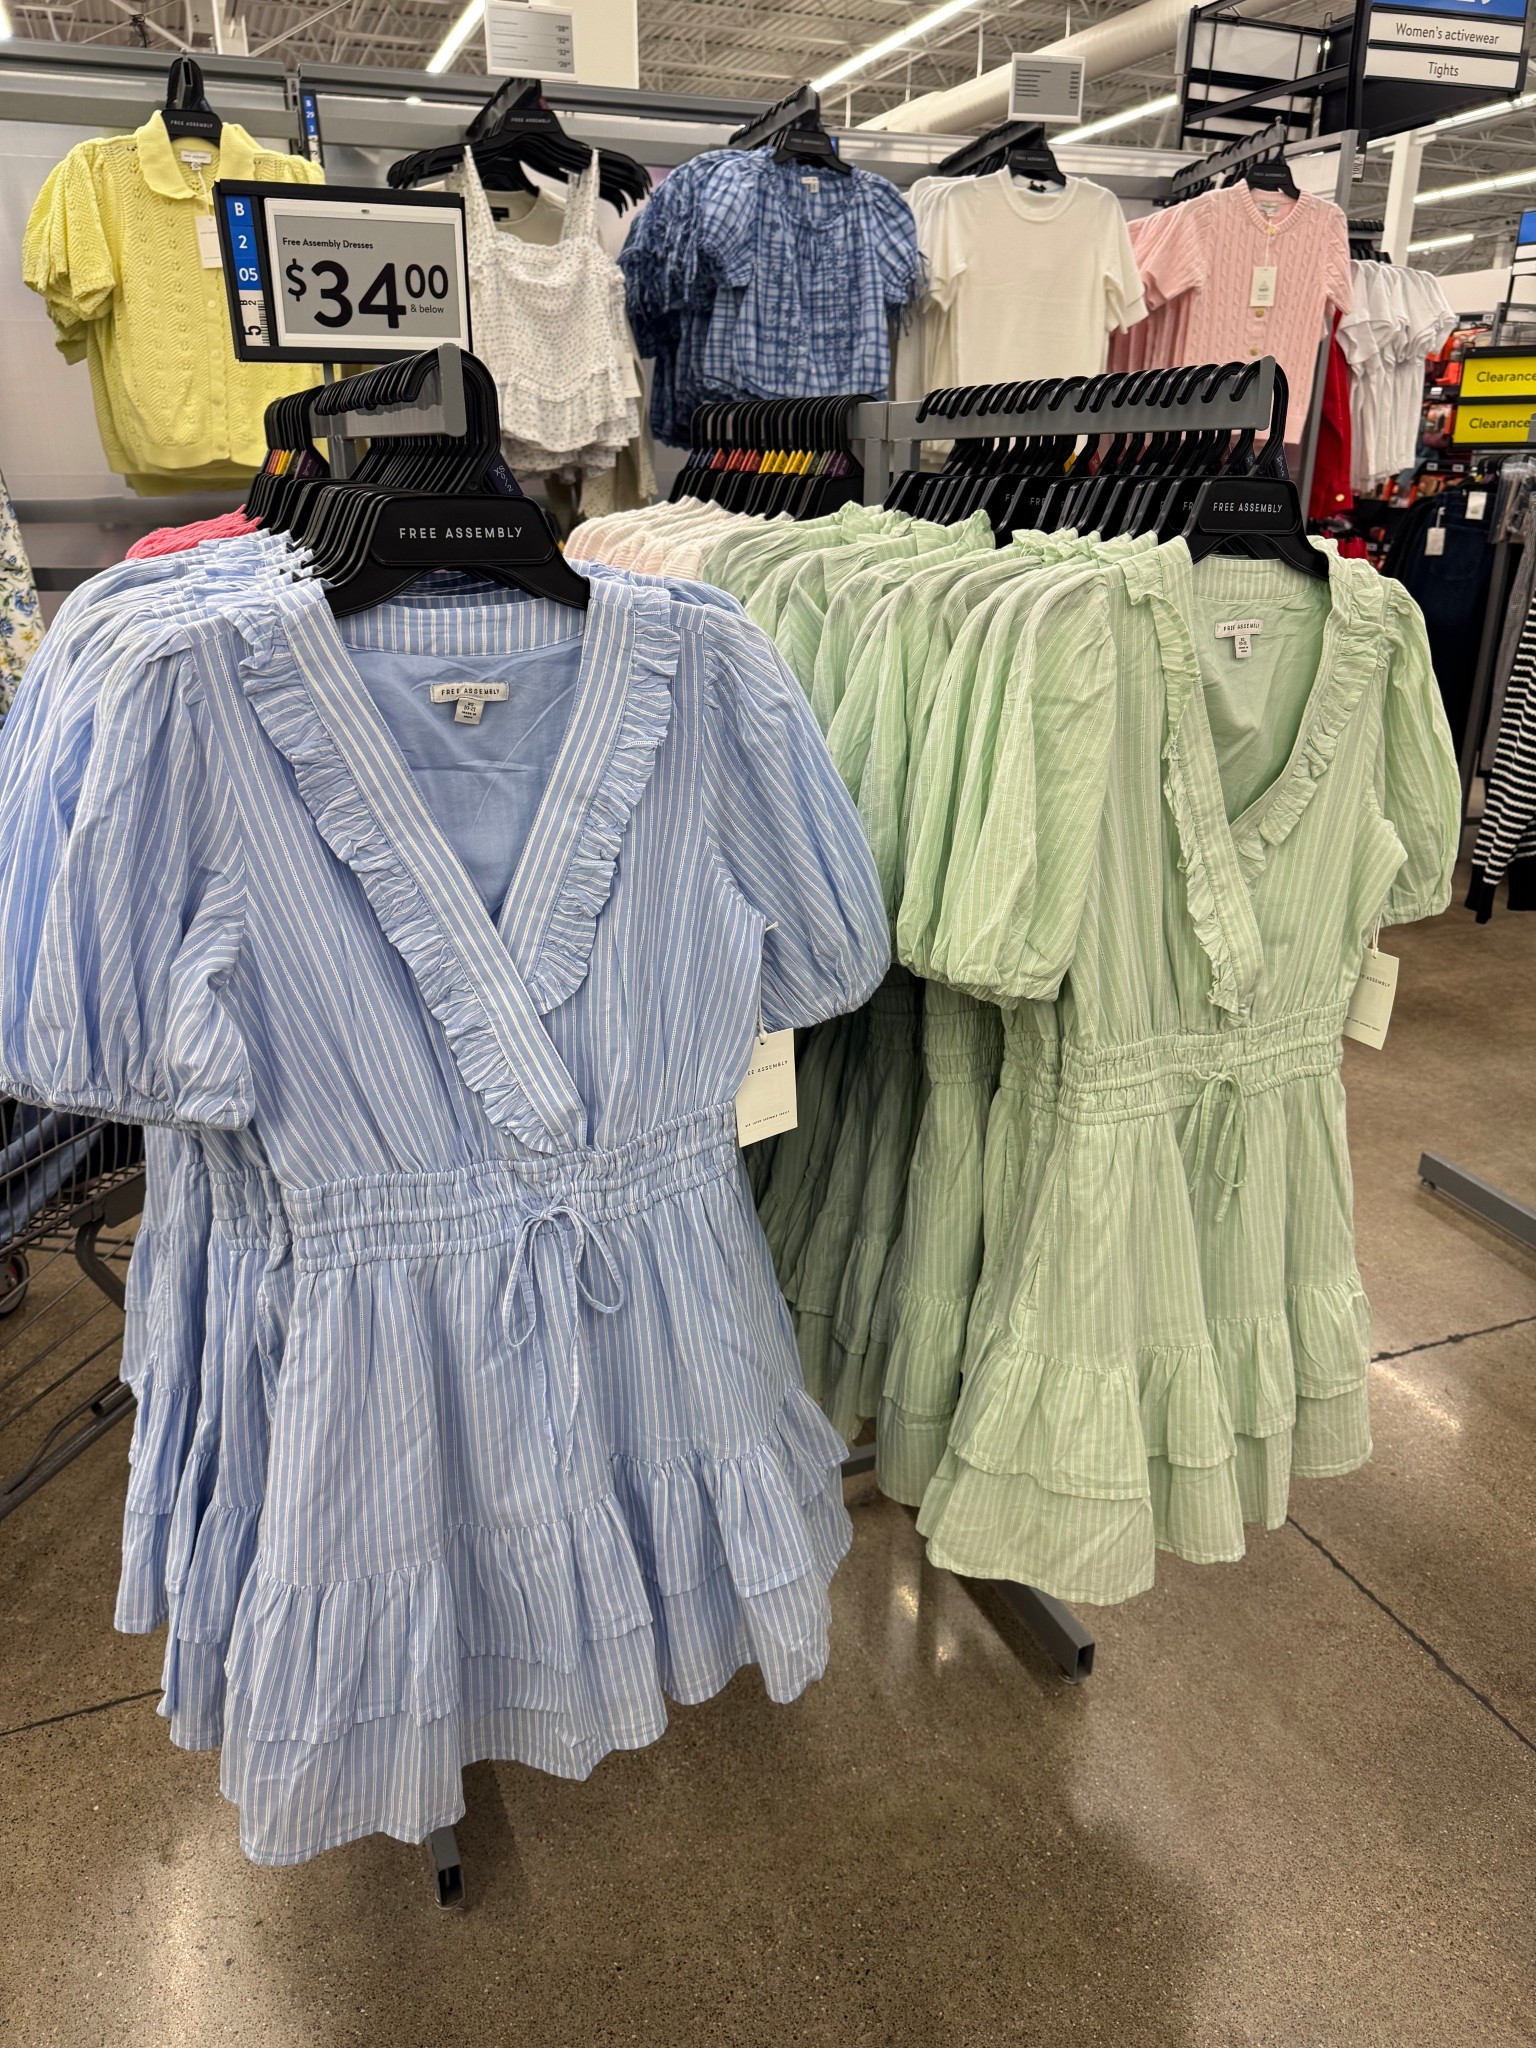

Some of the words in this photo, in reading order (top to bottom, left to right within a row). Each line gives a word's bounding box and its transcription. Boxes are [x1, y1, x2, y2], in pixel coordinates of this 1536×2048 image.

[1395, 22, 1443, 39] Women's
[1444, 29, 1500, 45] activewear
[1428, 61, 1459, 78] Tights
[234, 202, 245, 217] B
[238, 235, 248, 249] 2
[282, 237, 301, 247] Free
[302, 239, 341, 250] Assembly
[343, 240, 374, 250] Dresses
[239, 268, 258, 282] 05
[410, 304, 417, 313] &
[419, 304, 445, 314] below
[1469, 417, 1531, 429] Clearance
[1212, 502, 1235, 512] FREE
[1237, 502, 1283, 513] ASSEMBLY
[399, 527, 437, 539] FREE
[445, 526, 523, 539] ASSEMBLY
[464, 687, 500, 695] ASSEMBLY
